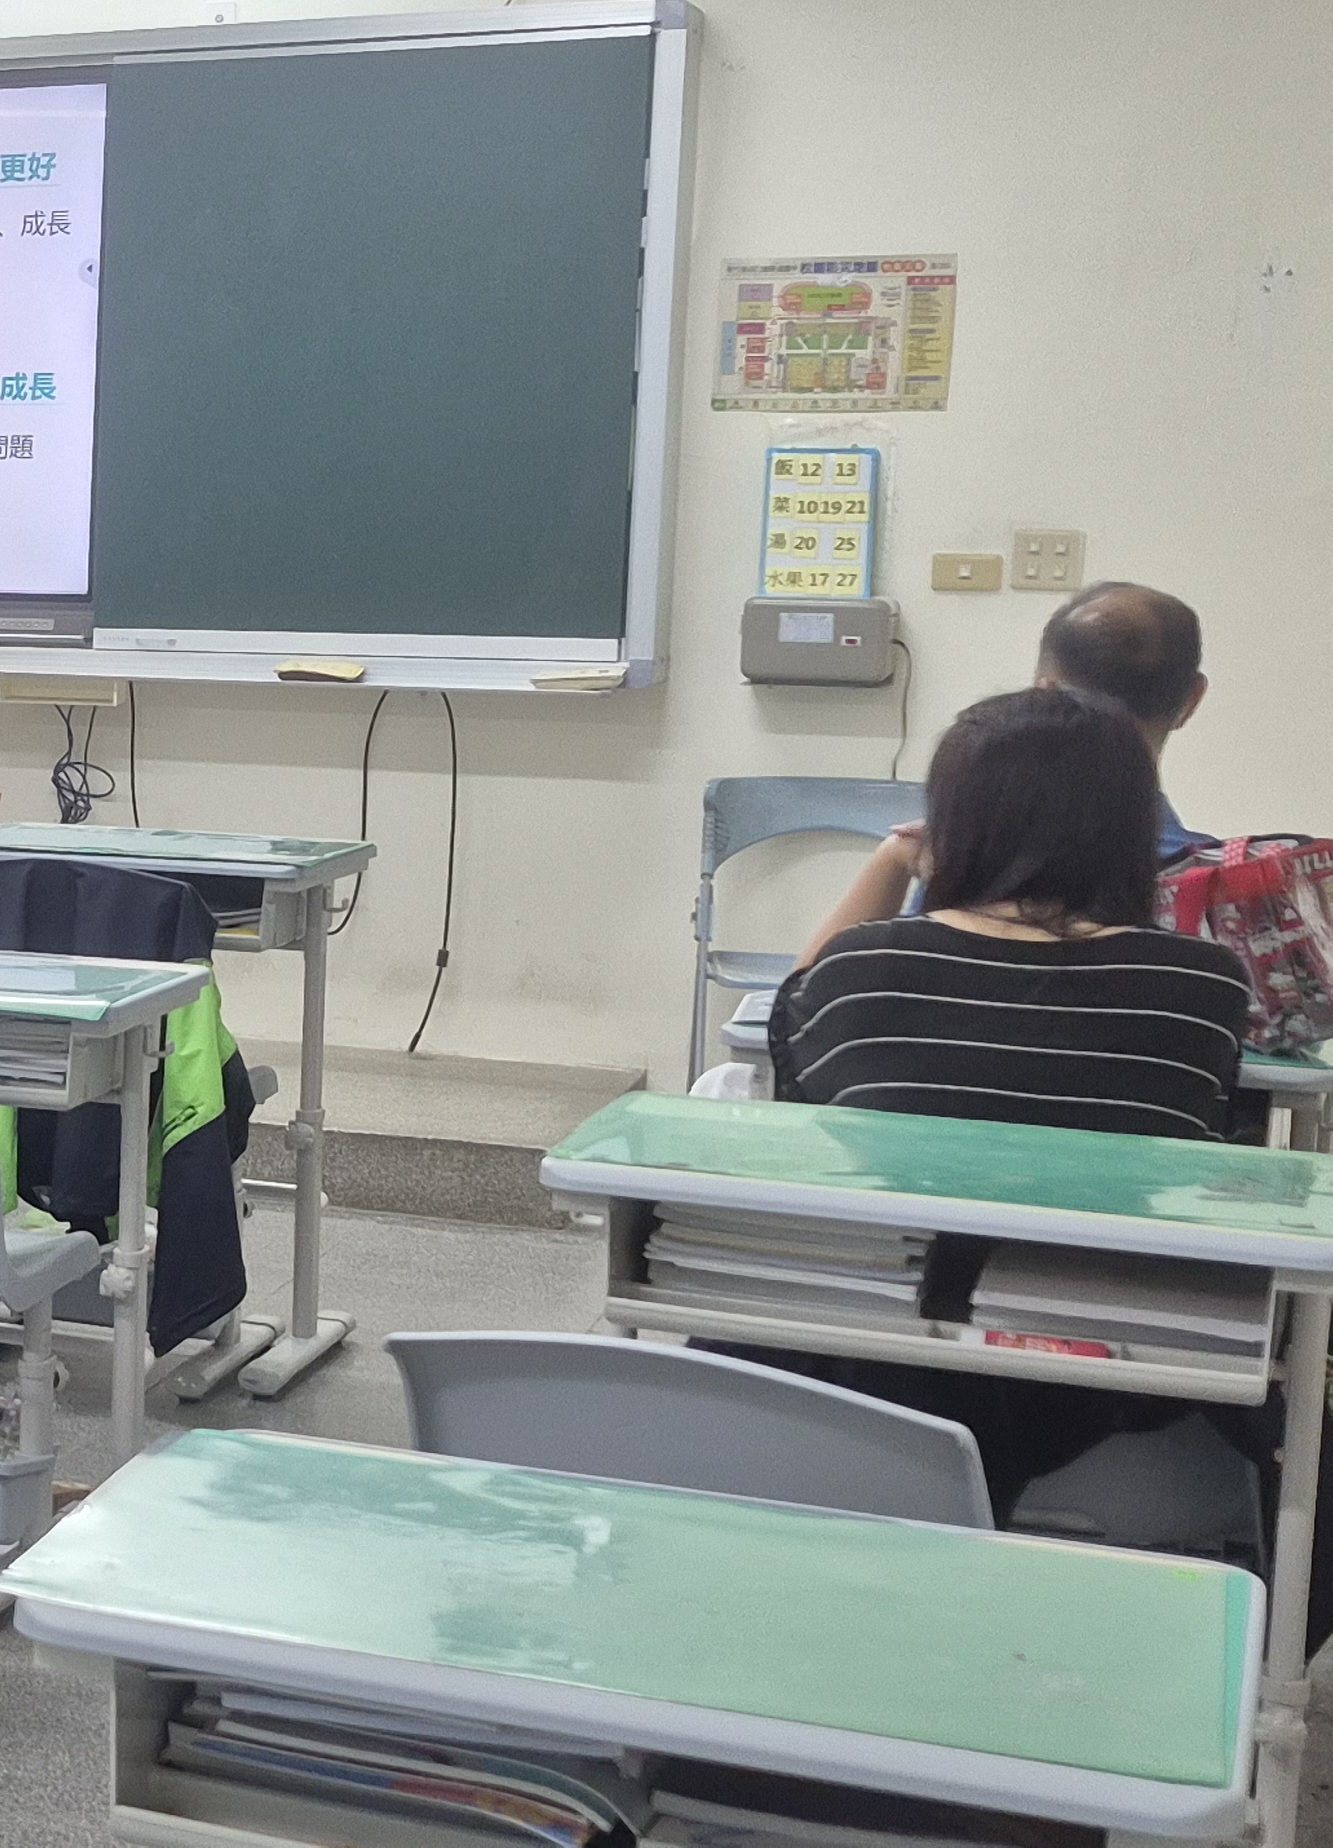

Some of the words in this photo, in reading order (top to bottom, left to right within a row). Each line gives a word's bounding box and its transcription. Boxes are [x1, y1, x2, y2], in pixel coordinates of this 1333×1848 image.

[773, 458, 794, 477] 飯
[799, 462, 822, 477] 12
[835, 462, 857, 477] 13
[772, 496, 791, 514] 菜
[797, 499, 819, 515] 10
[819, 500, 843, 516] 19
[844, 499, 867, 515] 21
[793, 536, 817, 551] 20
[833, 536, 857, 552] 25
[765, 570, 804, 589] 水果
[808, 573, 830, 588] 17
[835, 573, 858, 588] 27
